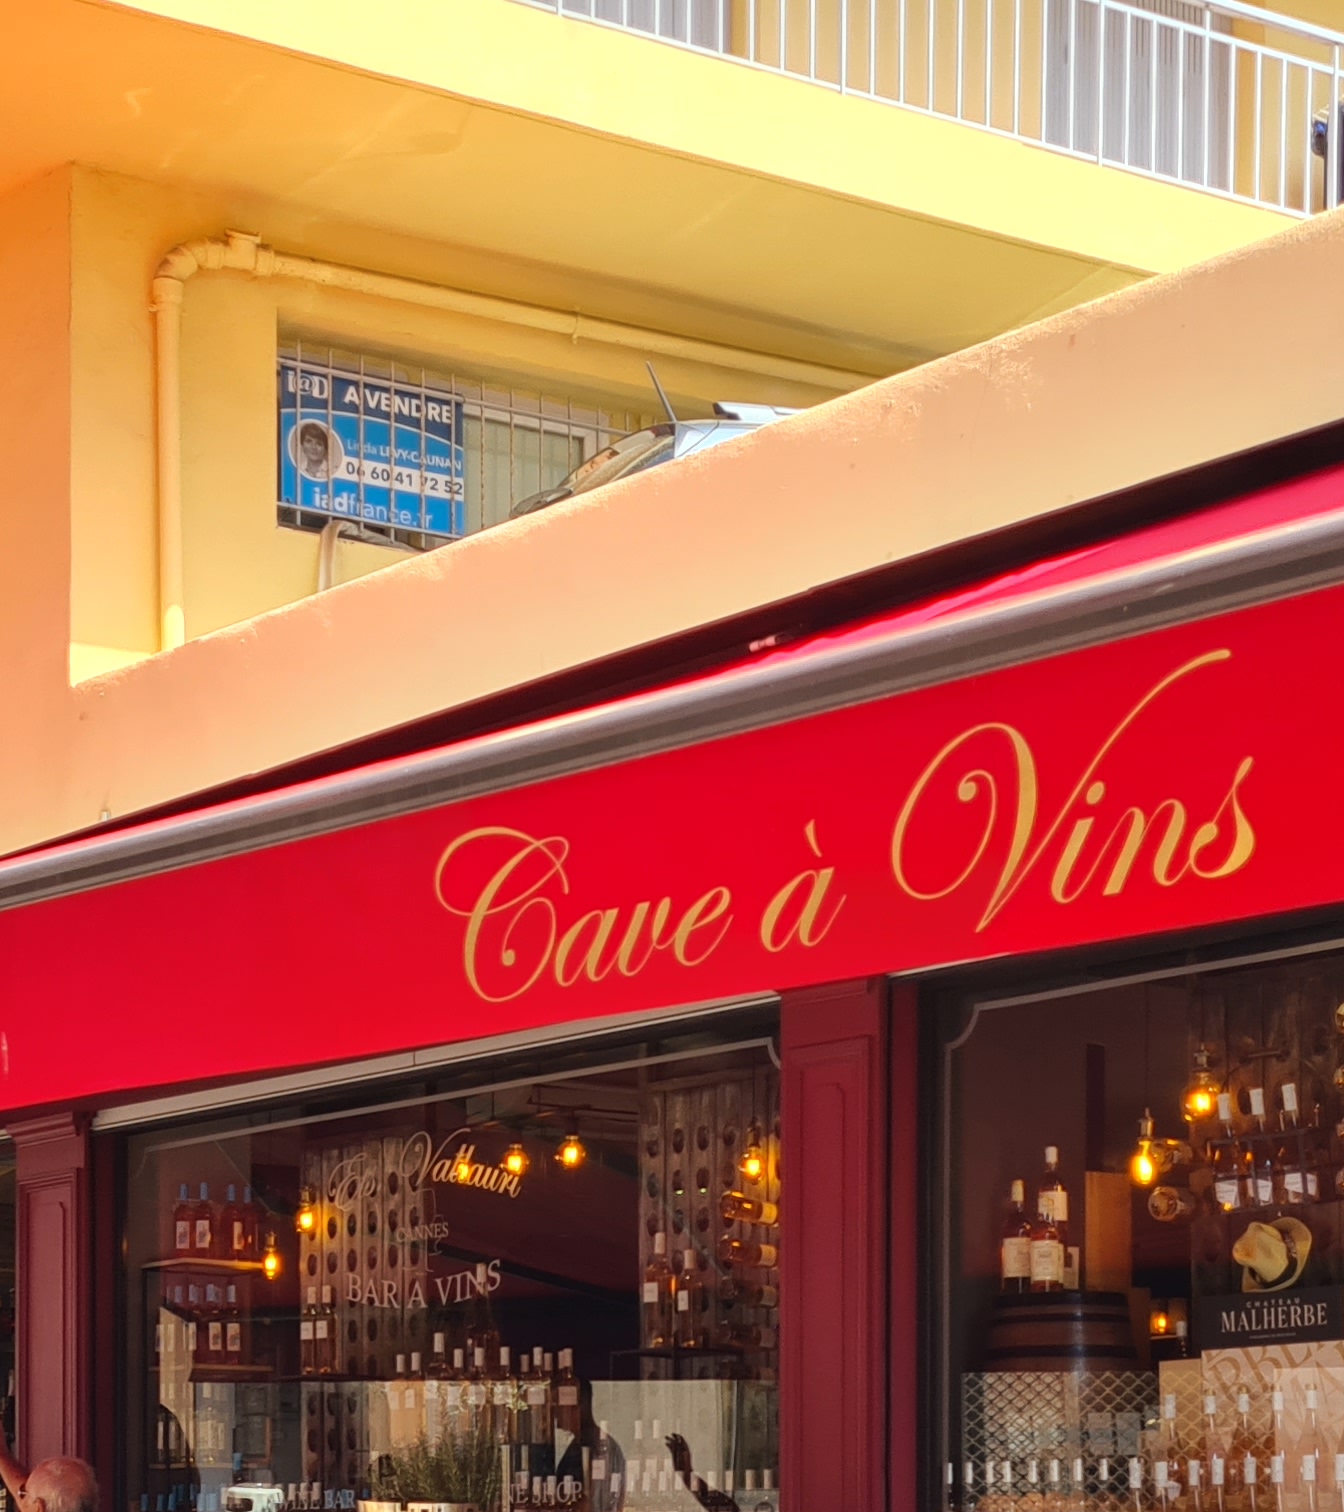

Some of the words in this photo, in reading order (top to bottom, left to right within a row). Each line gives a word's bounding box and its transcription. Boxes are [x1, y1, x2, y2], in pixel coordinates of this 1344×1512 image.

[344, 386, 360, 405] A
[364, 389, 452, 424] VENDRE
[371, 467, 390, 482] 60
[395, 472, 412, 487] 41
[444, 481, 463, 495] 52
[435, 825, 734, 1003] Cave
[759, 818, 847, 952] à
[892, 649, 1255, 932] Vins
[396, 1222, 449, 1243] CANNES
[346, 1272, 400, 1309] BAR
[407, 1281, 428, 1308] A
[434, 1259, 502, 1305] VINS
[1221, 1303, 1328, 1333] MALHERBE
[323, 1488, 356, 1510] BAR
